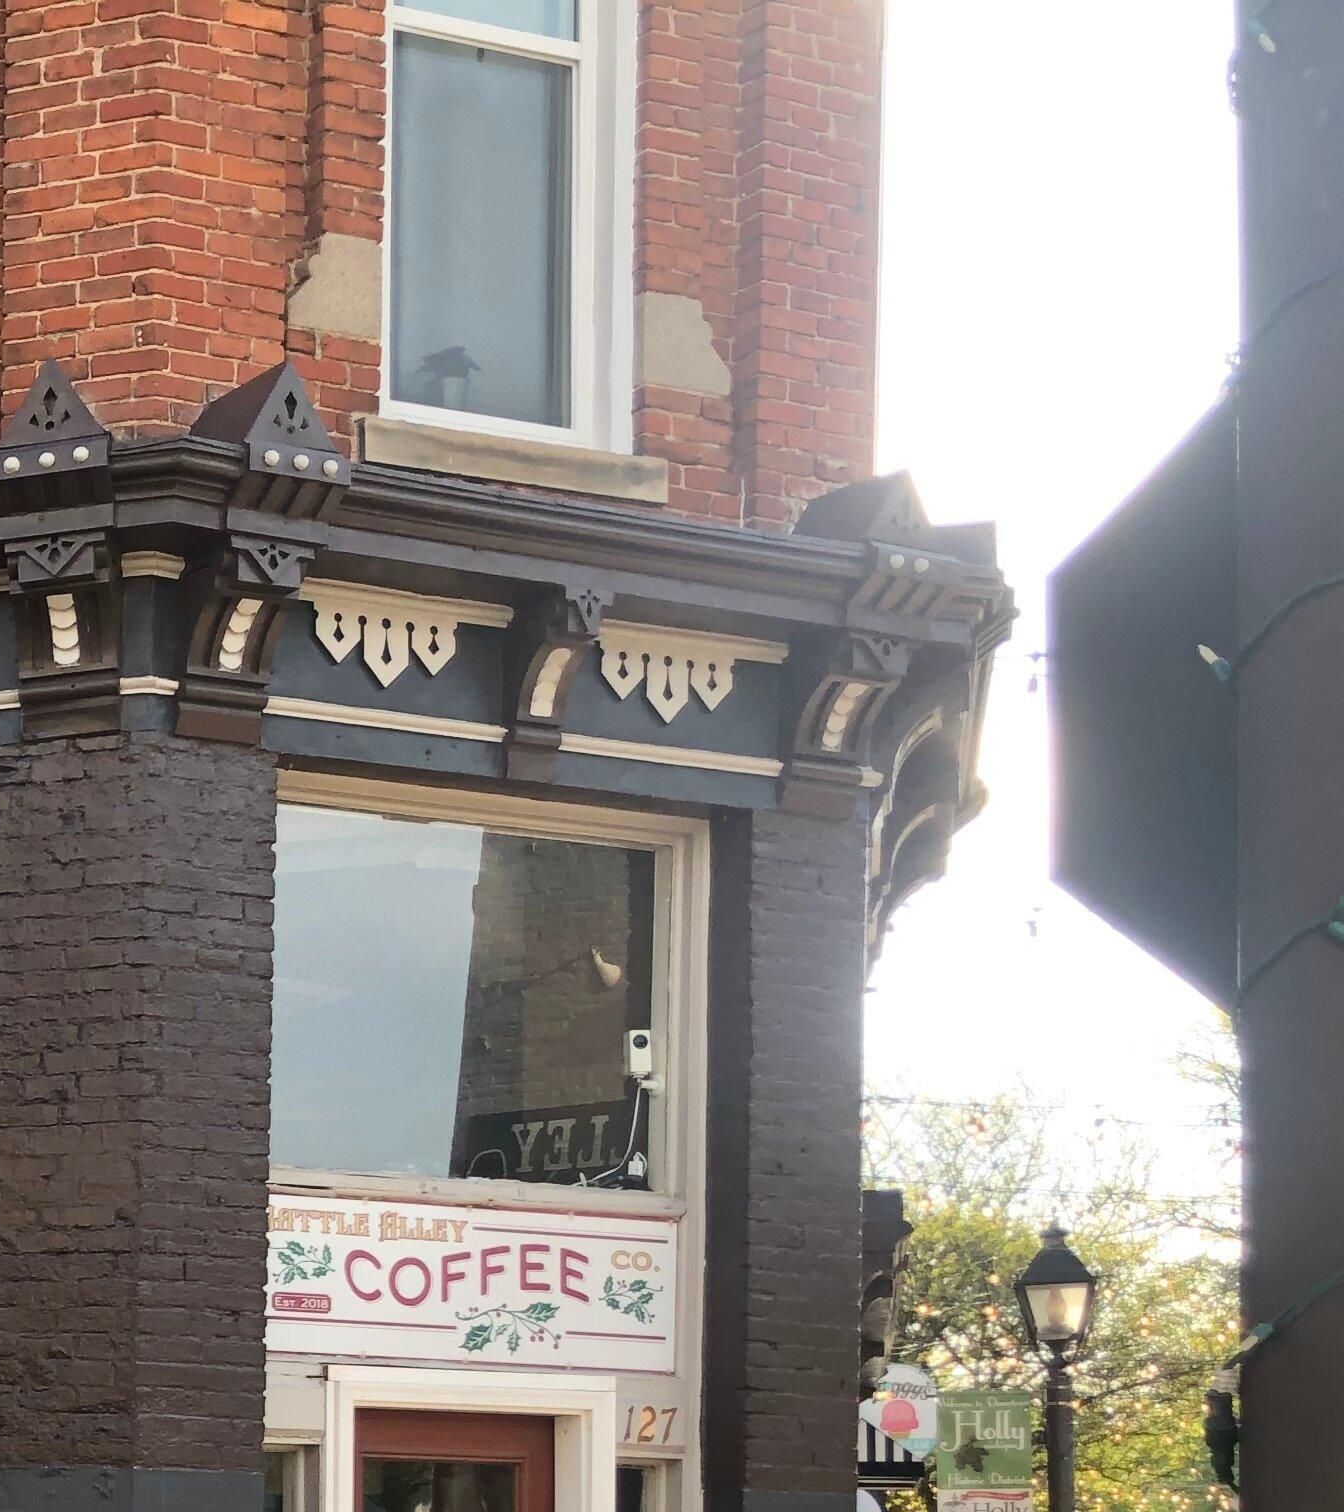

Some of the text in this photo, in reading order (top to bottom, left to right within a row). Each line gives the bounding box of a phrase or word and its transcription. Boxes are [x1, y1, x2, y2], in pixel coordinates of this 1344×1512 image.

[344, 1243, 590, 1307] COFFEE
[301, 1297, 329, 1310] 2018
[623, 1405, 678, 1445] 127
[939, 1409, 1025, 1452] Holly
